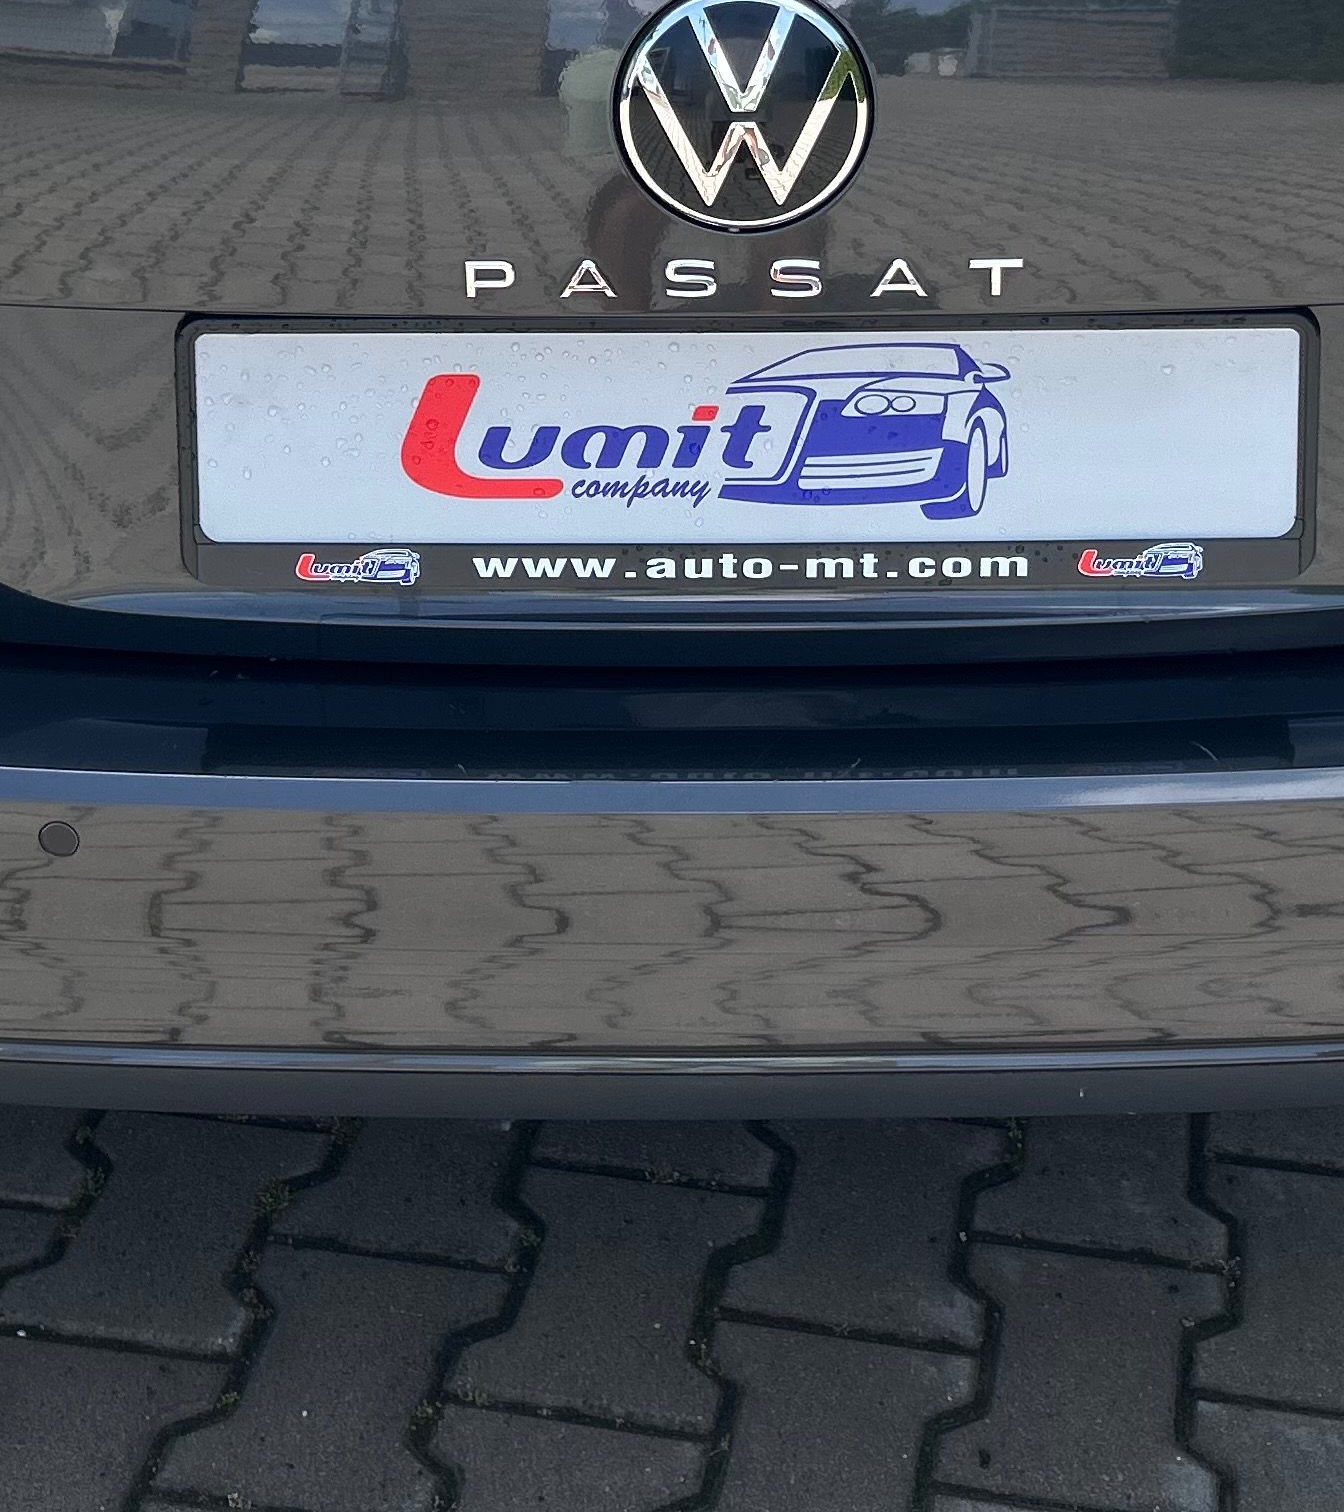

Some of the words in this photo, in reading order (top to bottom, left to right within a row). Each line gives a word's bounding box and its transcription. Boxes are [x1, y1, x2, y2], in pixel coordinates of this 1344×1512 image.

[462, 257, 1025, 299] PASSAT
[400, 373, 772, 500] Lumit
[570, 476, 712, 507] company
[471, 554, 1029, 579] www.auto-mt.com
